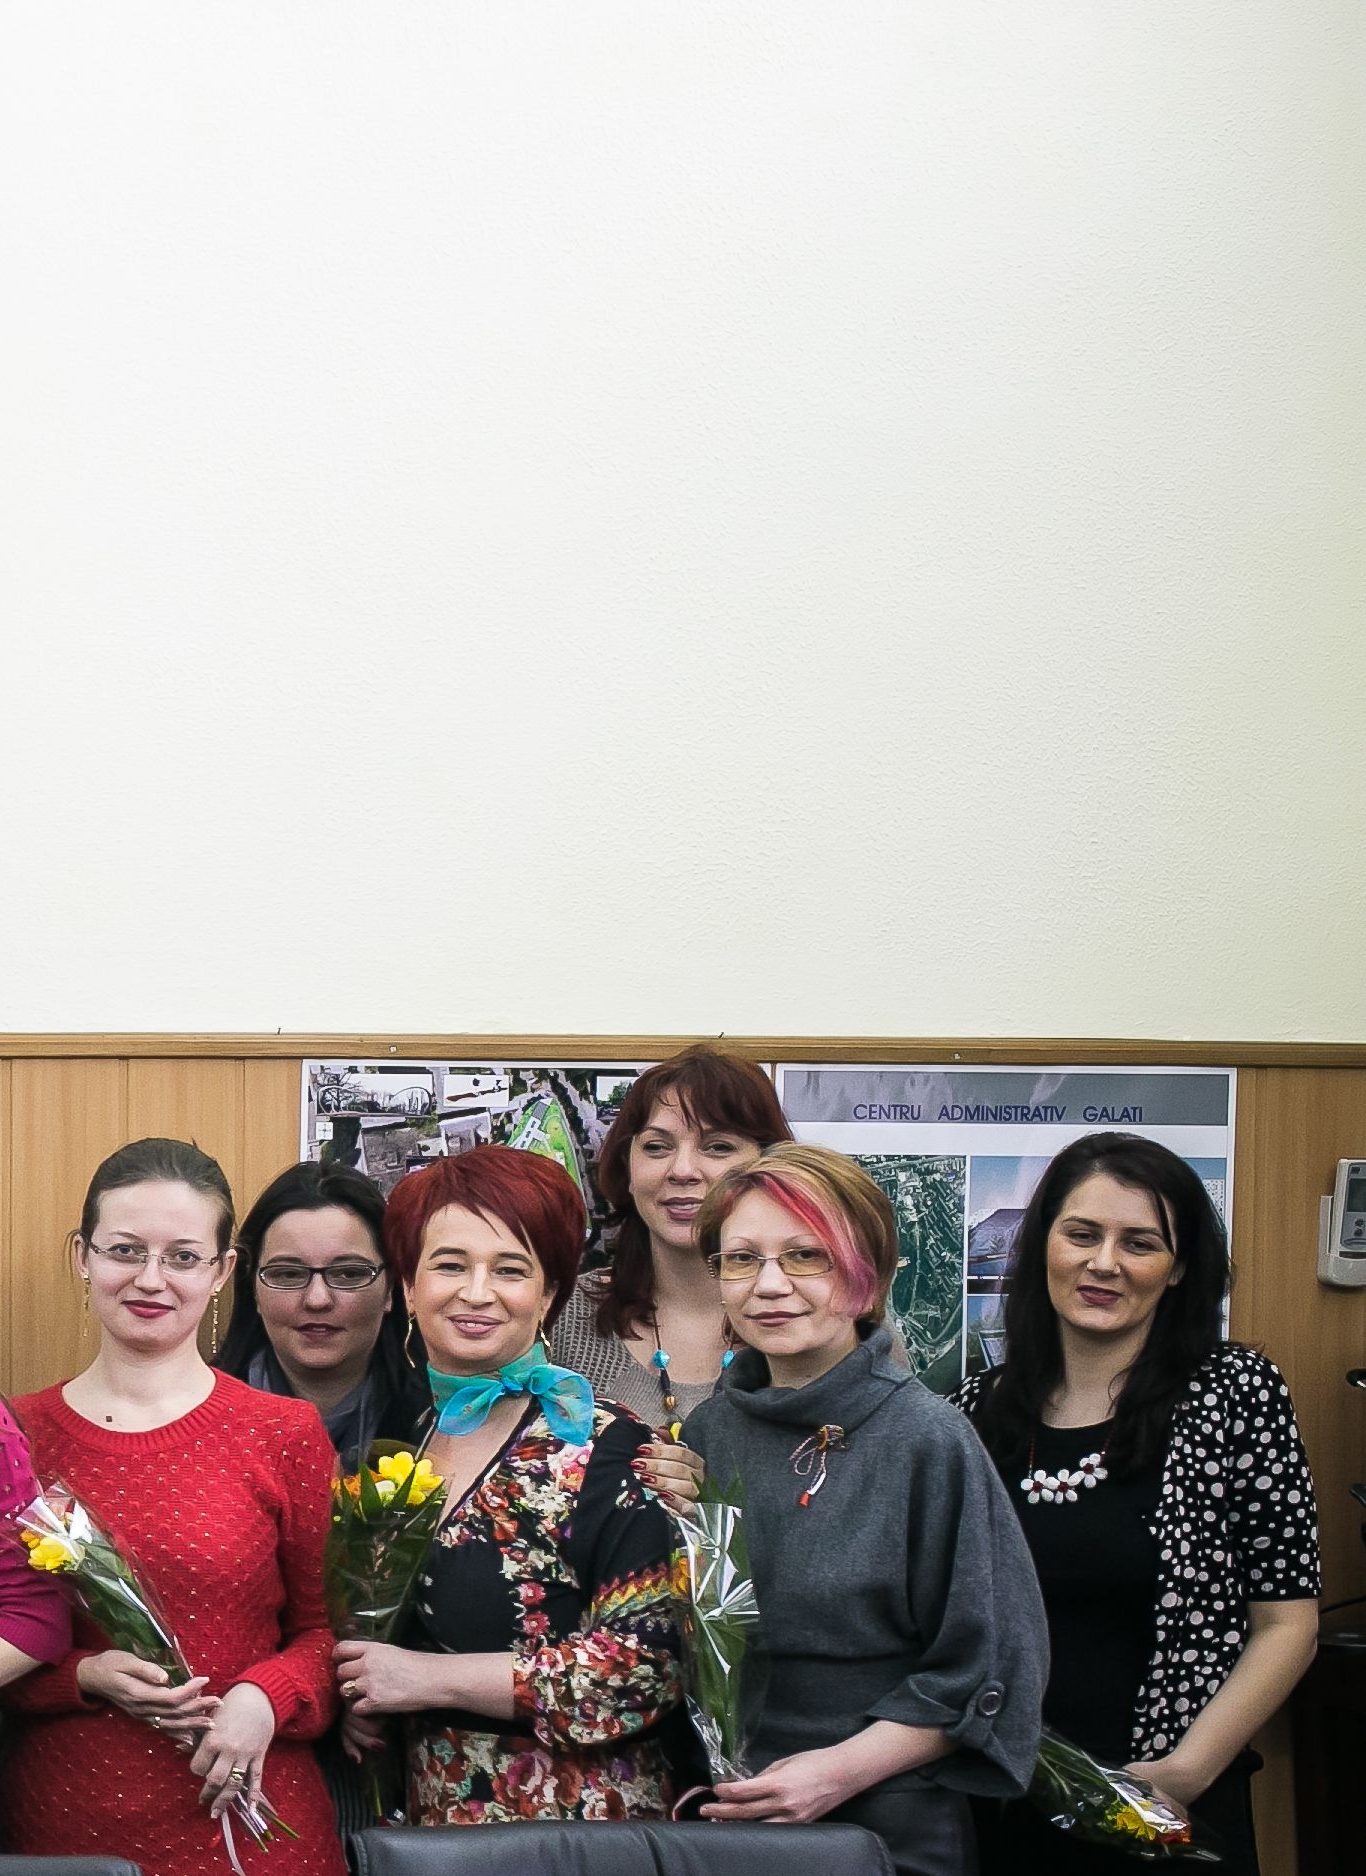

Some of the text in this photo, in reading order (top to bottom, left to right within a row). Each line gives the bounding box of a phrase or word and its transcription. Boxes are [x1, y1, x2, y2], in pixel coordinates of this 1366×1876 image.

[853, 1103, 1143, 1123] CENTRU ADMINISTRATIV GALATI
